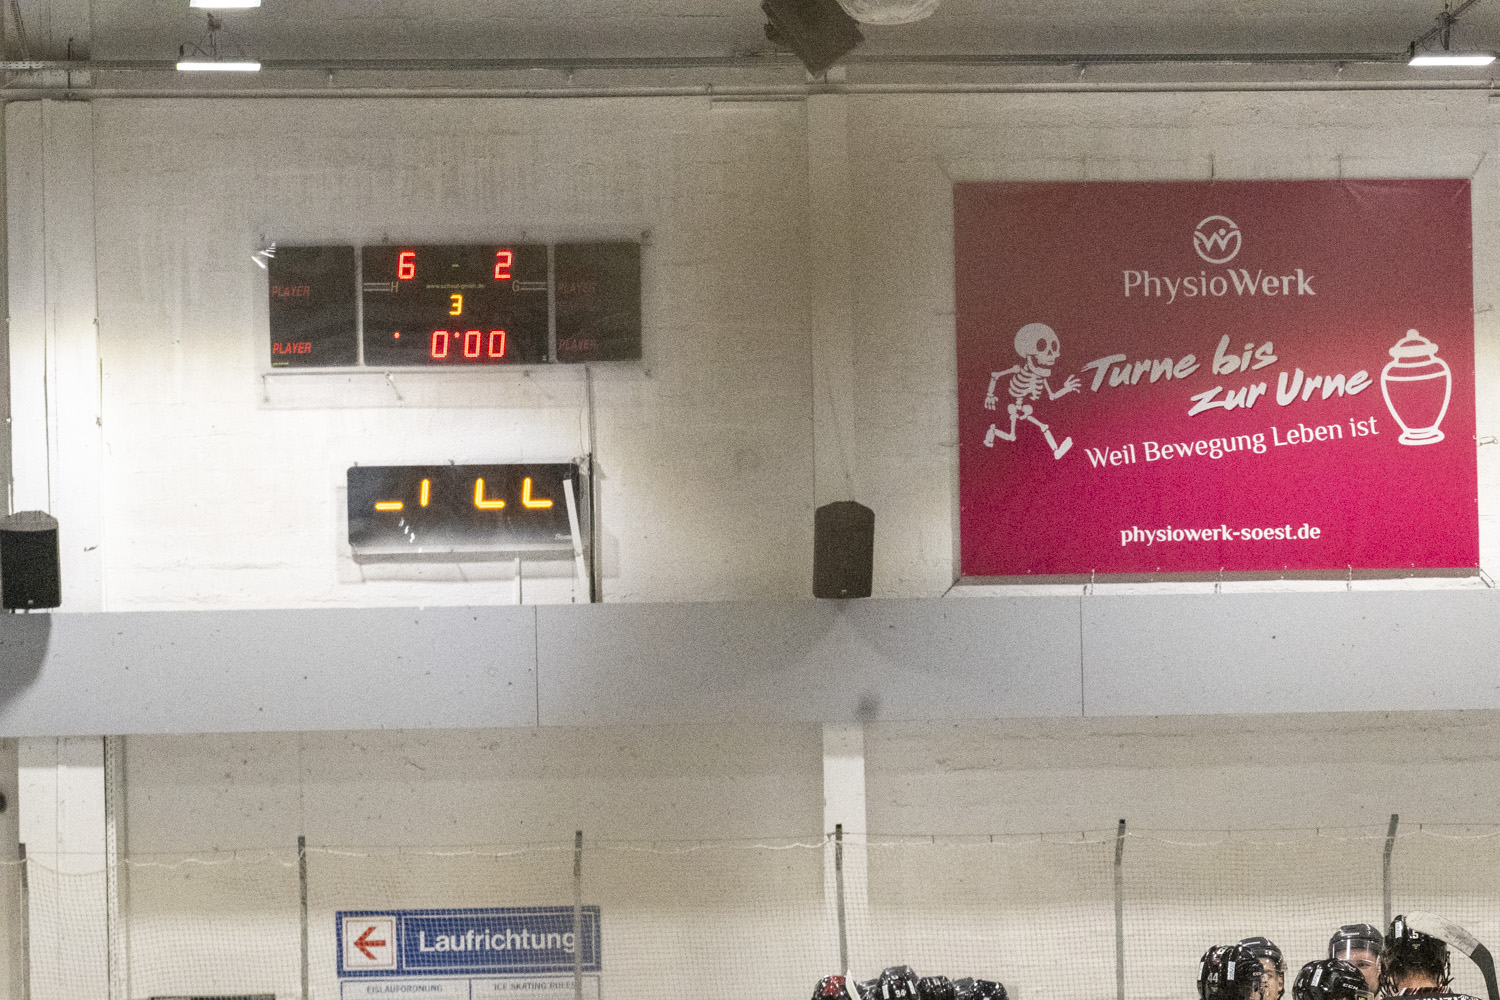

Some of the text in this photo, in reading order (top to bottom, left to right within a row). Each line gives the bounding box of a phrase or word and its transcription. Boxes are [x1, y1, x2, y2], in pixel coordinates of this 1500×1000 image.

[398, 251, 512, 280] 6 2
[272, 286, 310, 298] PLAYER
[1122, 269, 1316, 304] PhysioWerk
[449, 294, 463, 316] 3
[273, 343, 311, 354] PLAYER
[1081, 334, 1277, 392] Turne bis
[1188, 366, 1373, 417] zur Urne
[1084, 415, 1379, 469] Weil Bewegung Leben ist
[1120, 523, 1321, 547] physiowerk-soest.de
[419, 929, 575, 954] Laufrichtung
[511, 982, 547, 991] SKATING
